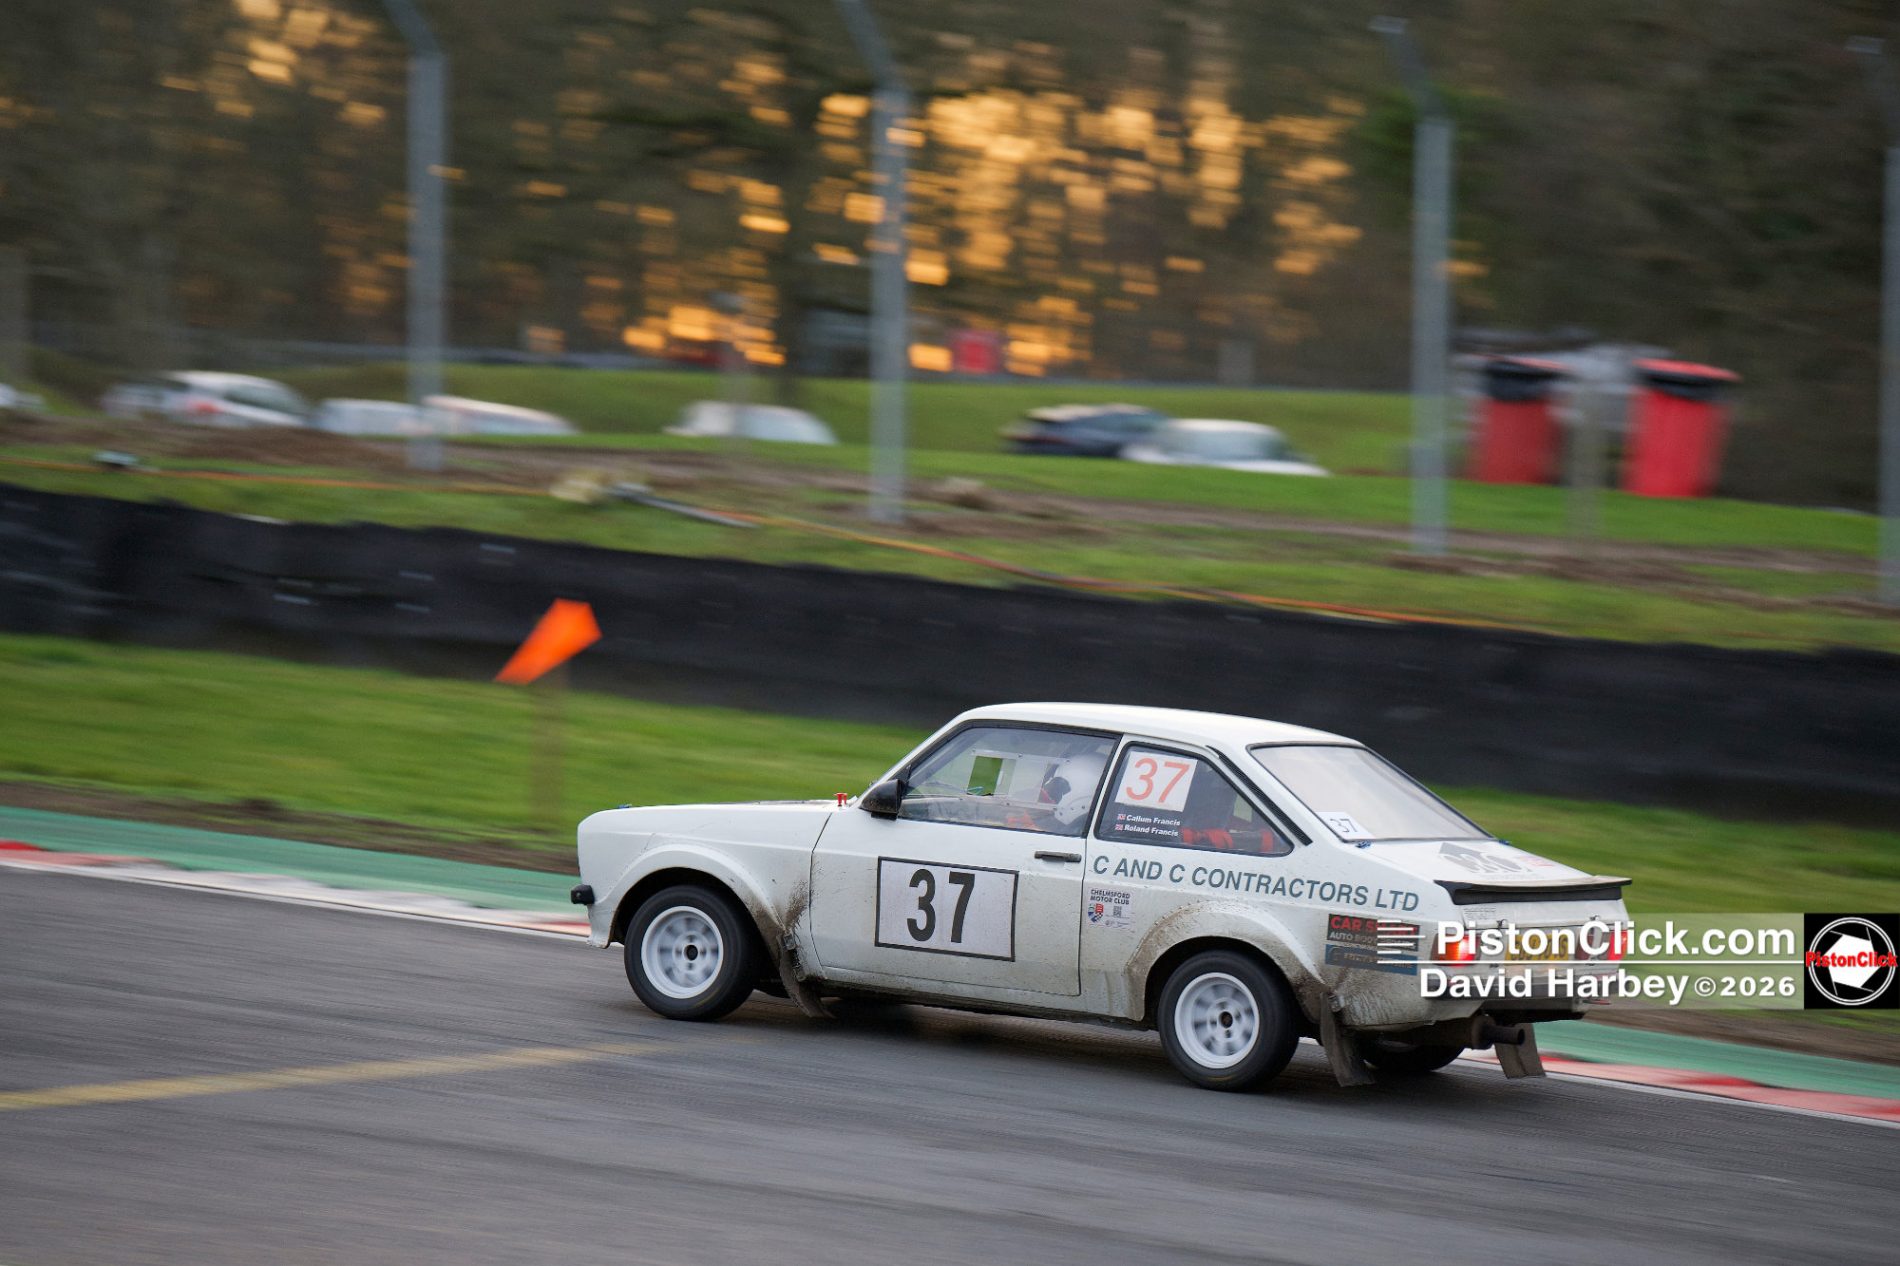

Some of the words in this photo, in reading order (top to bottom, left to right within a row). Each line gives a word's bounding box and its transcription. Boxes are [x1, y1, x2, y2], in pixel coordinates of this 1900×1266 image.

[1126, 757, 1190, 804] 37
[1126, 814, 1152, 824] Callum
[1153, 816, 1181, 826] Francis
[1329, 818, 1358, 834] 37
[1124, 825, 1150, 834] Roland
[1151, 826, 1179, 837] Francis
[1093, 855, 1110, 874] C
[1114, 858, 1163, 880] AND
[1169, 863, 1186, 883] C
[1191, 866, 1368, 906] CONTRACTORS
[1374, 888, 1419, 911] LTD
[1090, 889, 1131, 900] CHELMSFORD
[1090, 895, 1113, 903] MOTOR
[907, 868, 975, 944] 37
[1330, 916, 1361, 931] CAR
[1329, 931, 1353, 940] AUTO
